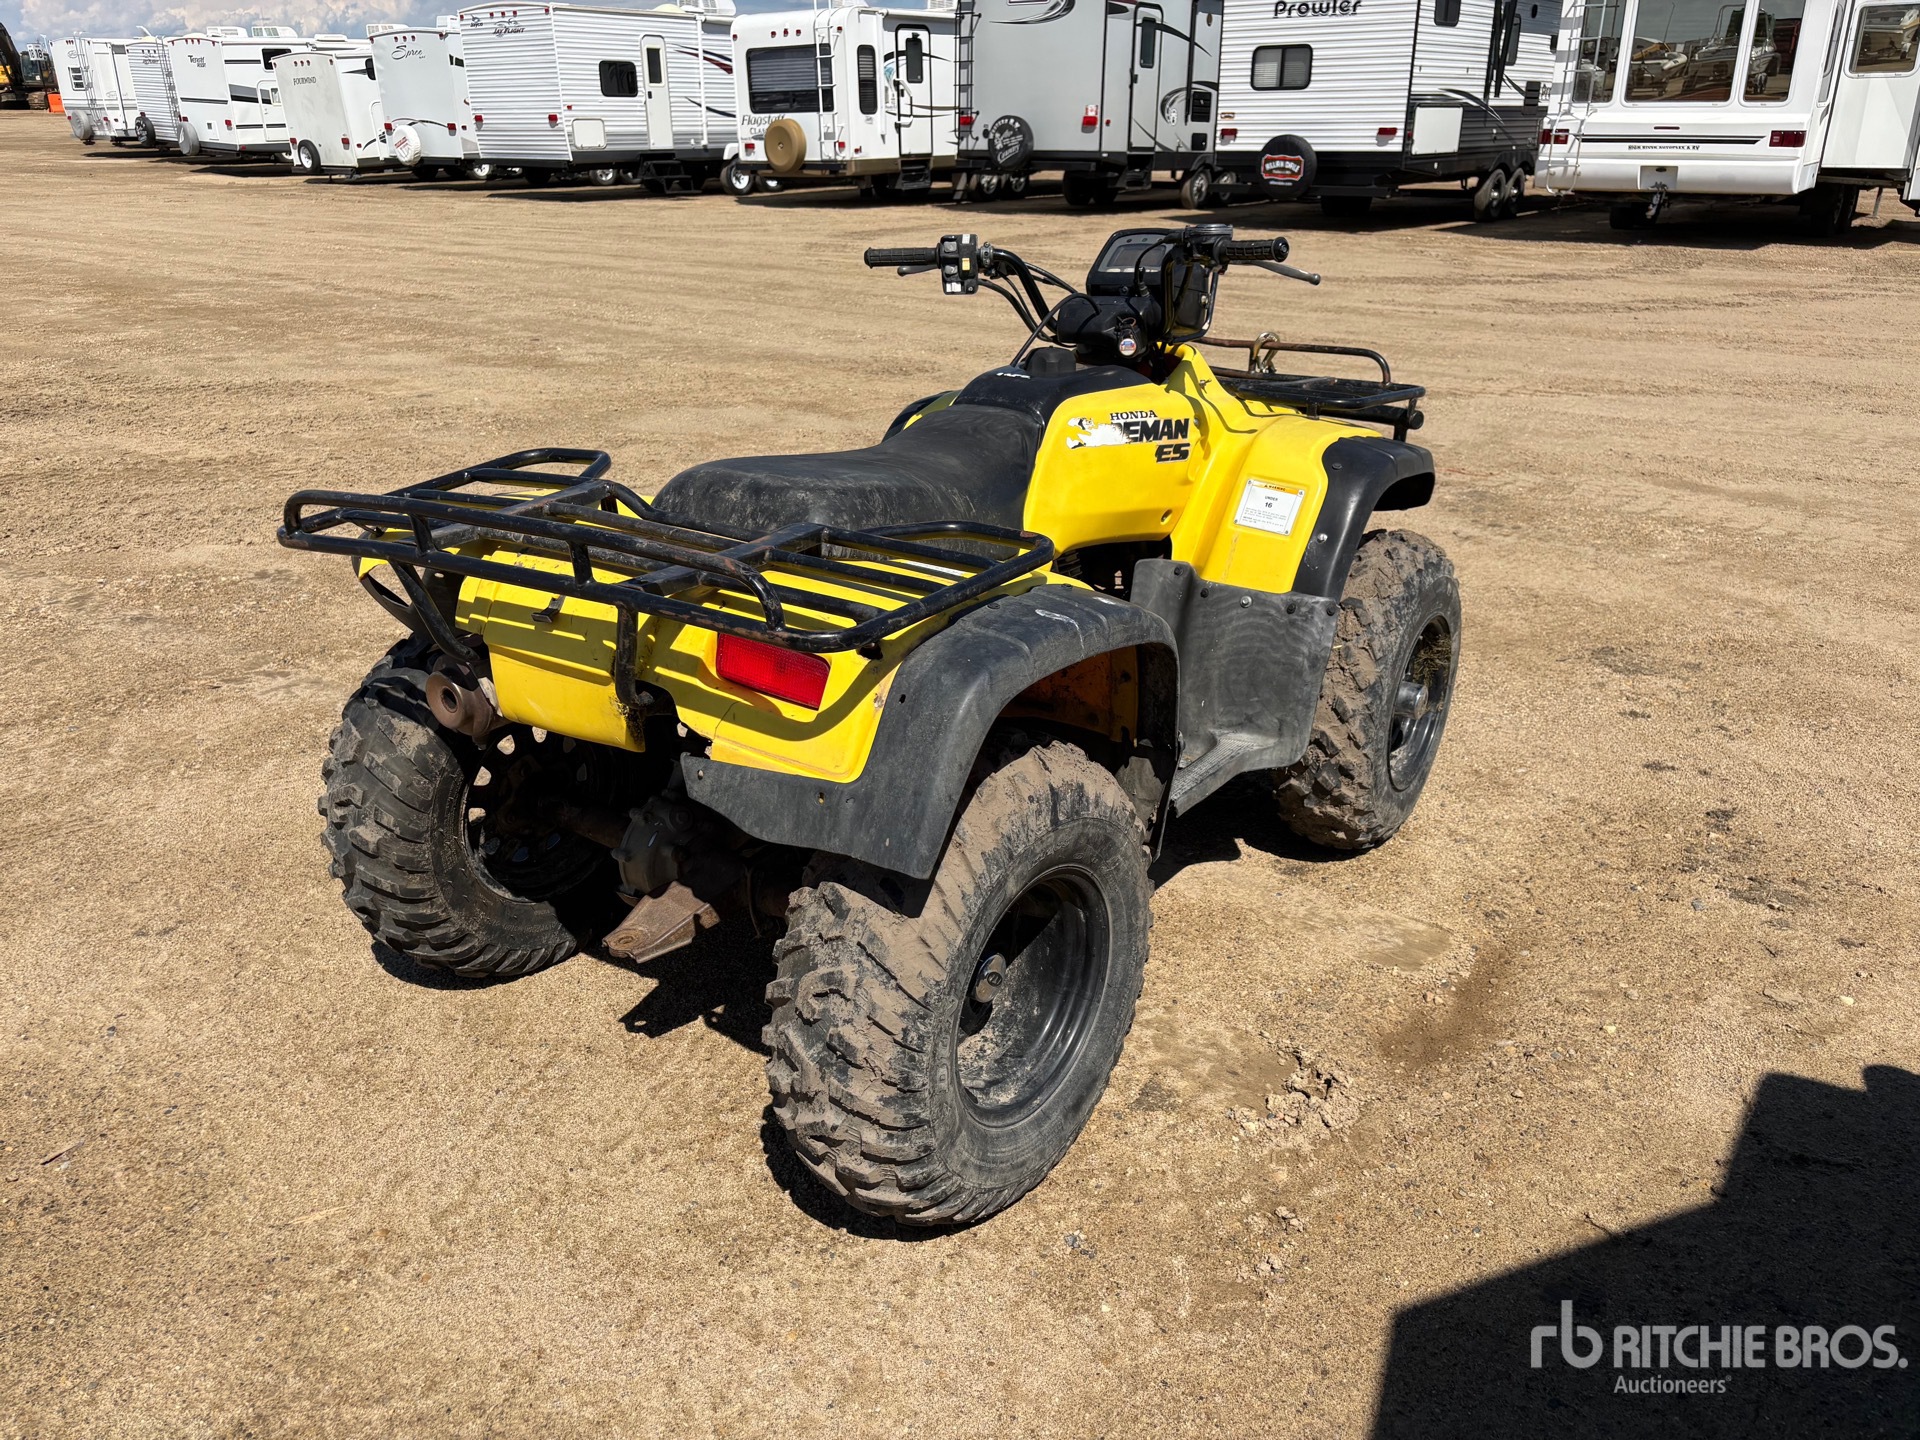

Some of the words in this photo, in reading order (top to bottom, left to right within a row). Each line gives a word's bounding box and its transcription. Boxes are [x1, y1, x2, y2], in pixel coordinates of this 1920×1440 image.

[1273, 0, 1361, 18] Prowler
[1110, 410, 1158, 420] HONDA
[1154, 443, 1191, 463] ES
